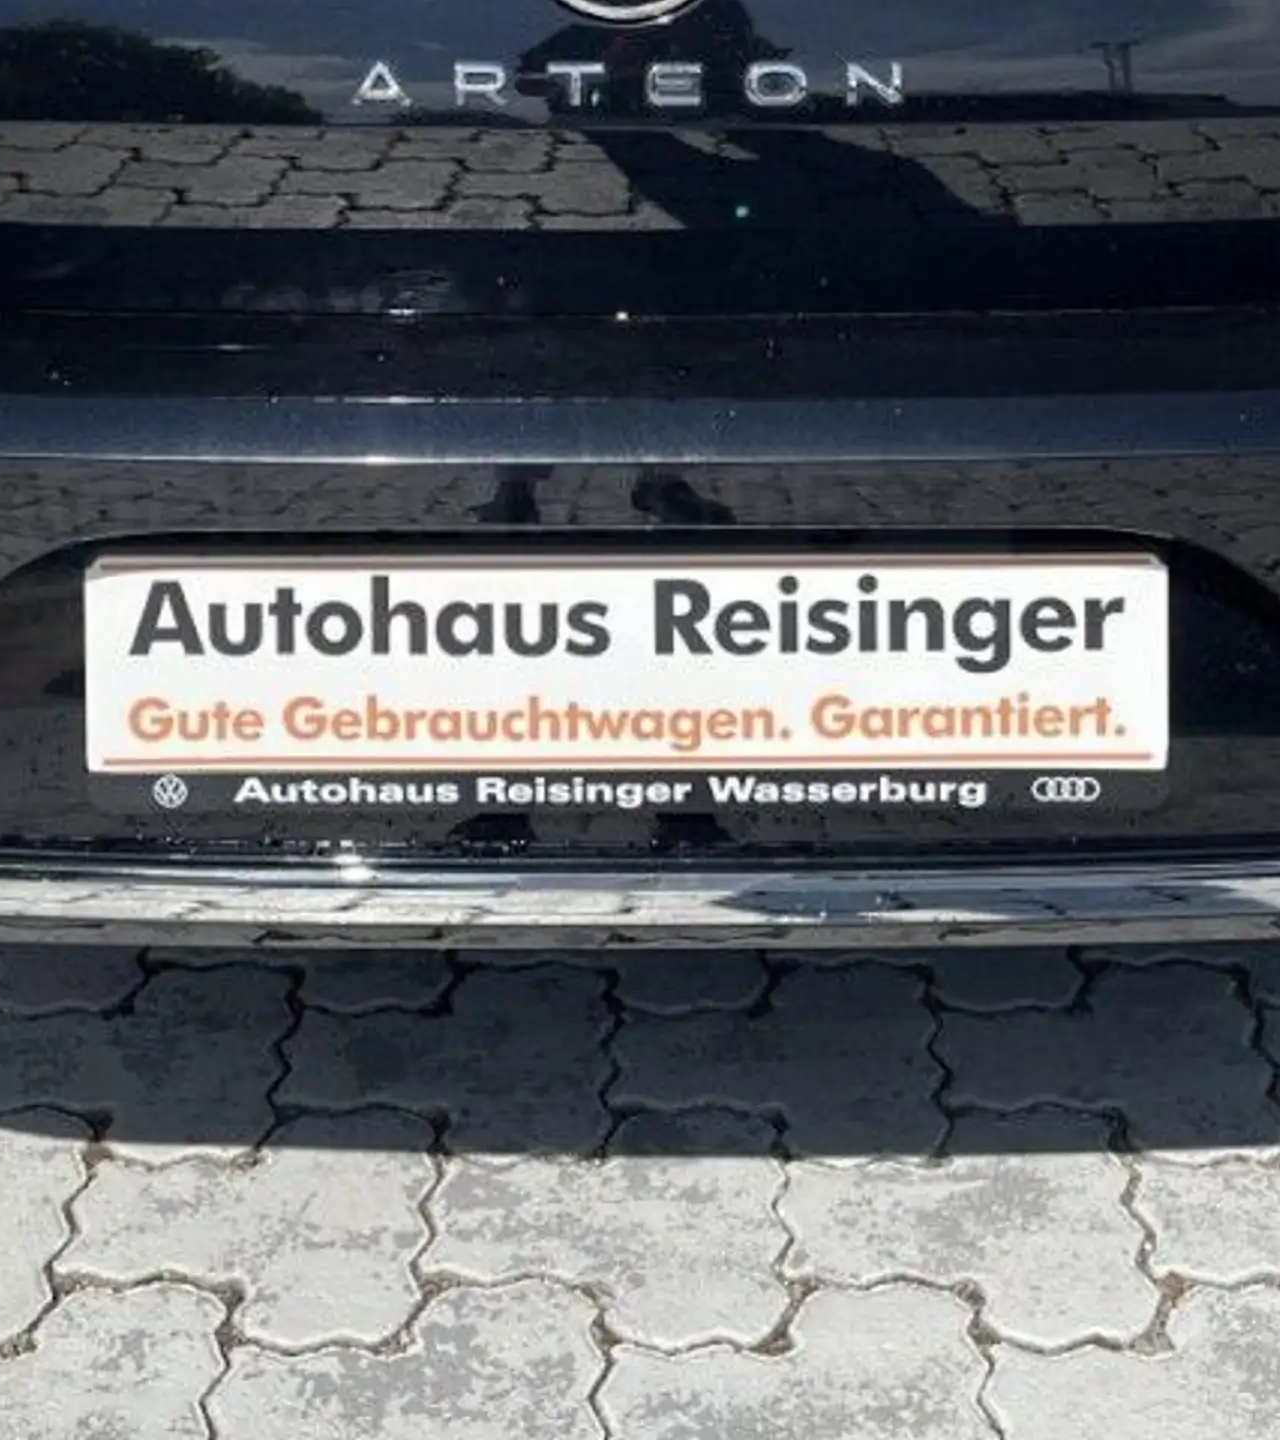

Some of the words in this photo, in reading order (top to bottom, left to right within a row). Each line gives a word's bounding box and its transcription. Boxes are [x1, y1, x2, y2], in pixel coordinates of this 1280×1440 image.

[353, 61, 904, 108] ARTEON
[129, 576, 610, 658] Autohaus
[654, 575, 1125, 673] Reisinger
[128, 696, 265, 743] Gute
[282, 696, 791, 751] Gebrauchtwagen.
[810, 692, 1128, 740] Garantiert.
[233, 777, 459, 804] Autohaus
[476, 776, 691, 808] Reisinger
[708, 776, 987, 808] Wasserburg
